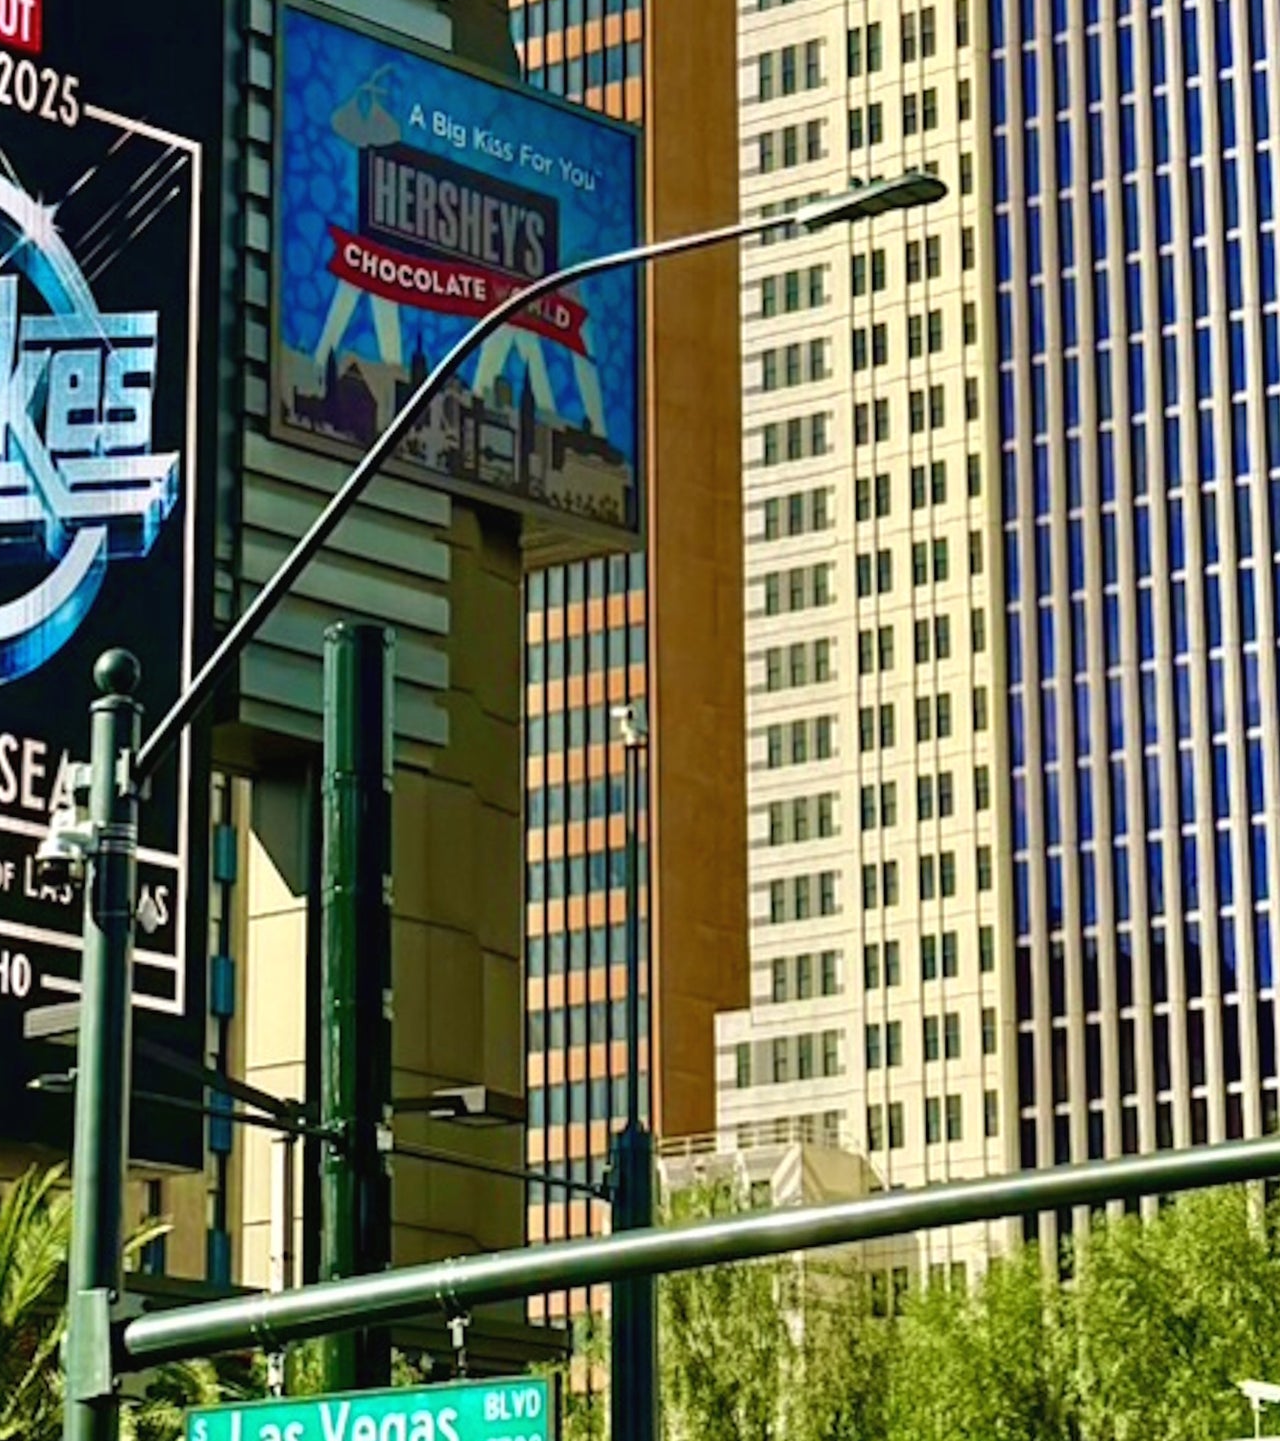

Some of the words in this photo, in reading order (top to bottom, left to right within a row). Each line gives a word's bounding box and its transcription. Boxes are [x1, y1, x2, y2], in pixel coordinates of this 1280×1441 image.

[408, 103, 426, 129] A
[433, 111, 466, 147] Big
[473, 127, 513, 162] Kiss
[520, 146, 553, 175] For
[374, 156, 546, 280] HERSHEY'S
[344, 242, 487, 301] CHOCOLATE
[484, 1388, 541, 1420] BLVD
